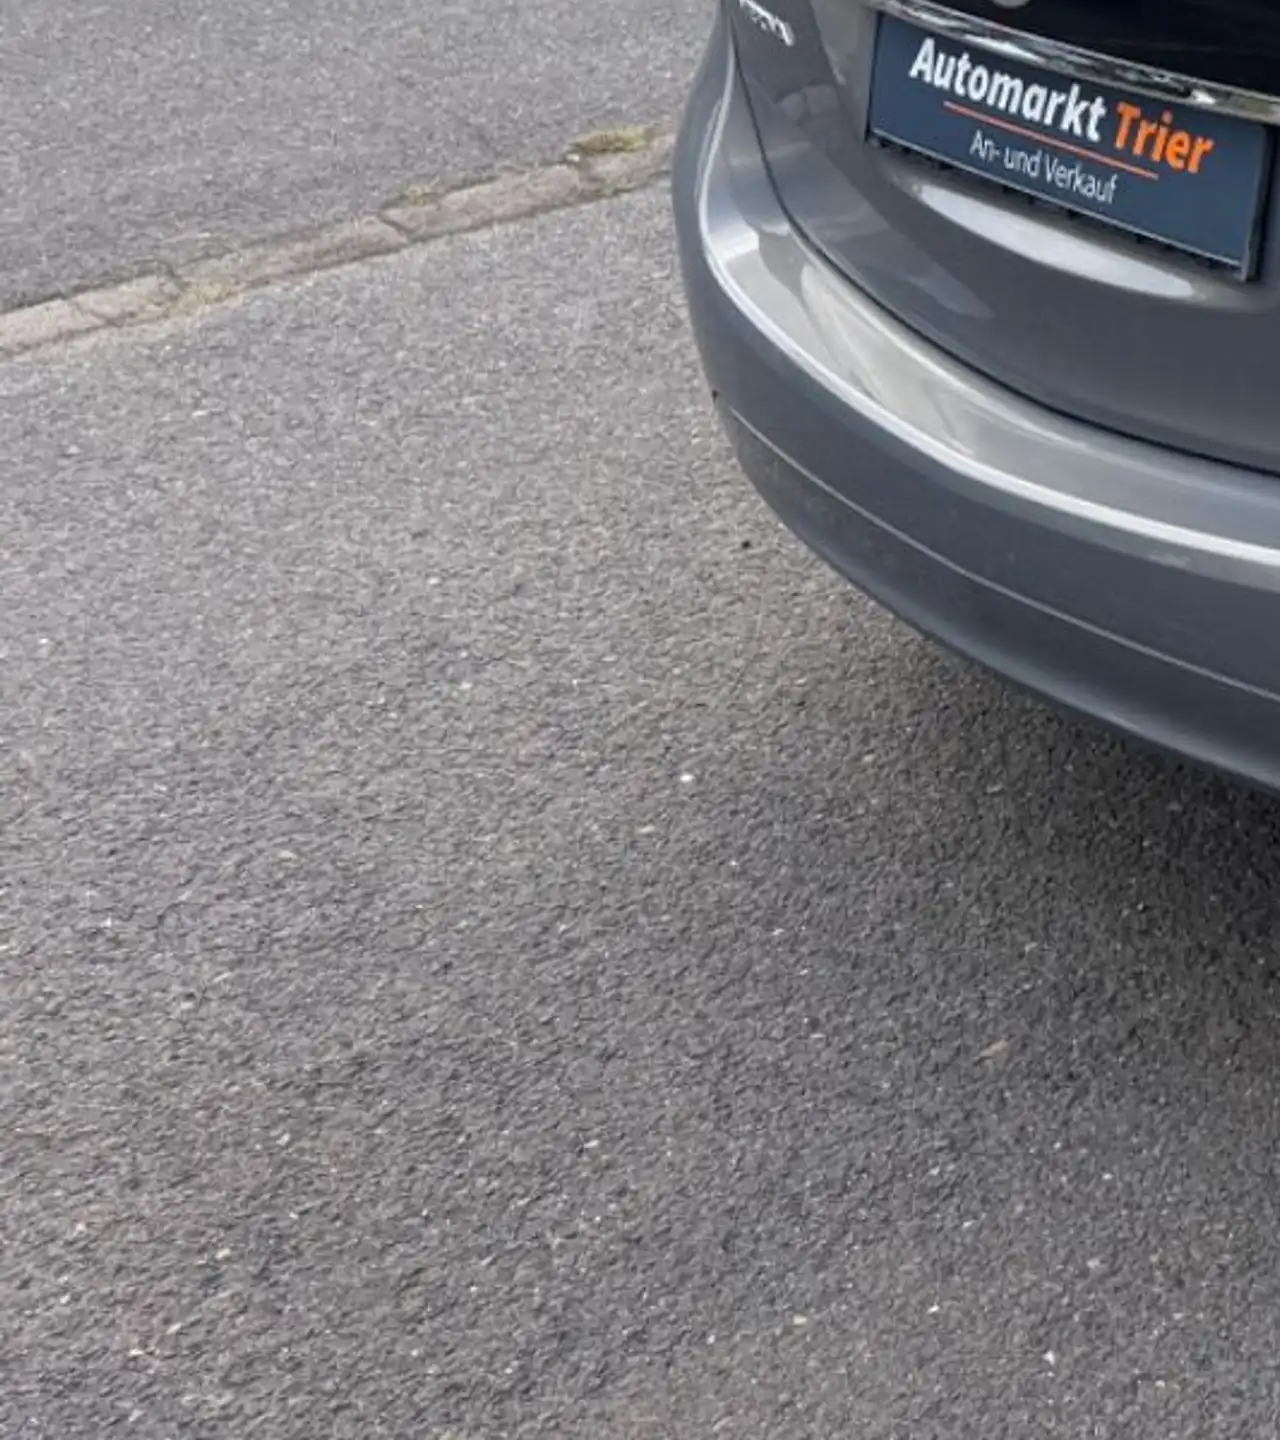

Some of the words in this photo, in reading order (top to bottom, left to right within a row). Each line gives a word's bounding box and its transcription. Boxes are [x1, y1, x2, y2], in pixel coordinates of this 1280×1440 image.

[908, 36, 1108, 143] Automarkt
[1115, 101, 1215, 174] Trier
[969, 129, 1000, 162] An-
[1003, 145, 1042, 177] und
[1044, 157, 1119, 205] Verkauf
